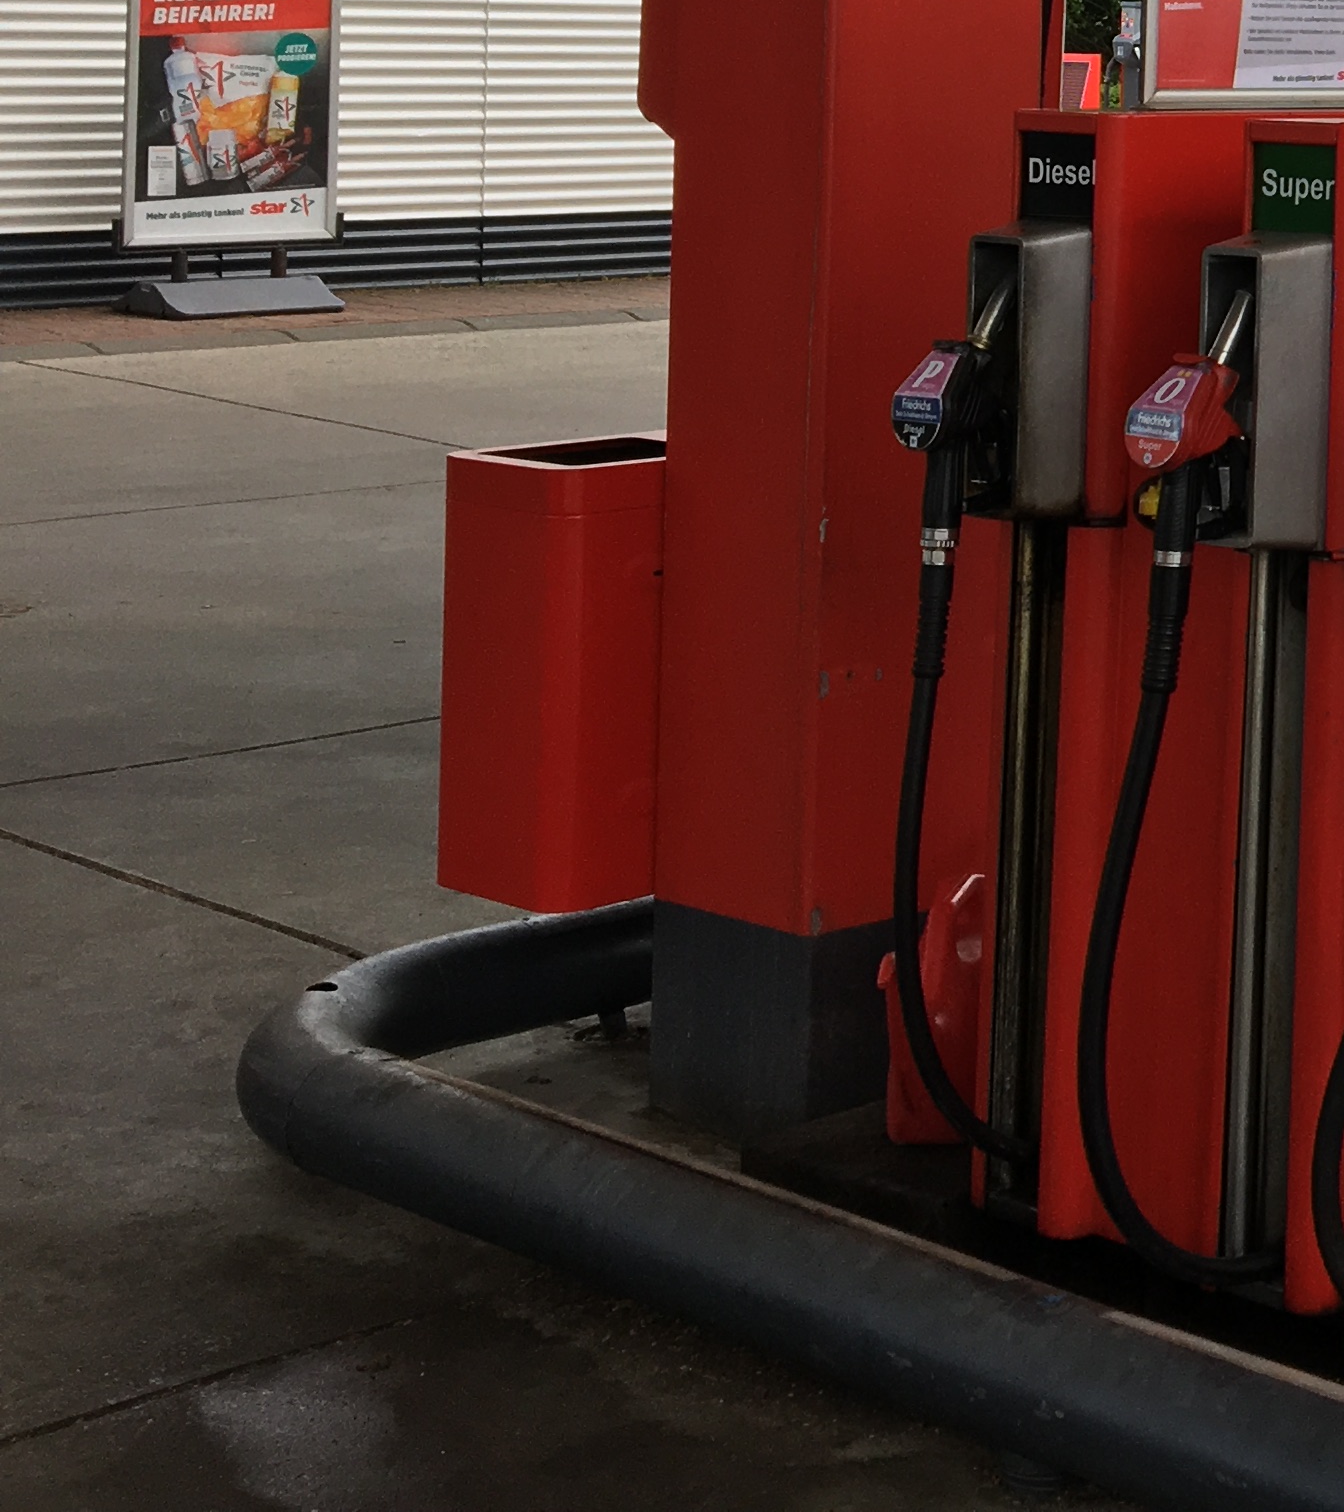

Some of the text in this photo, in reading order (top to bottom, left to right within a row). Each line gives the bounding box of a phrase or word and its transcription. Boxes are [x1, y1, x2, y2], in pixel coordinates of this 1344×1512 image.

[153, 3, 275, 25] BEIFAHRER!
[284, 44, 308, 54] JETZT
[1029, 157, 1096, 185] Diesel
[1262, 168, 1335, 205] Super
[250, 199, 287, 215] star
[1138, 438, 1162, 451] Super
